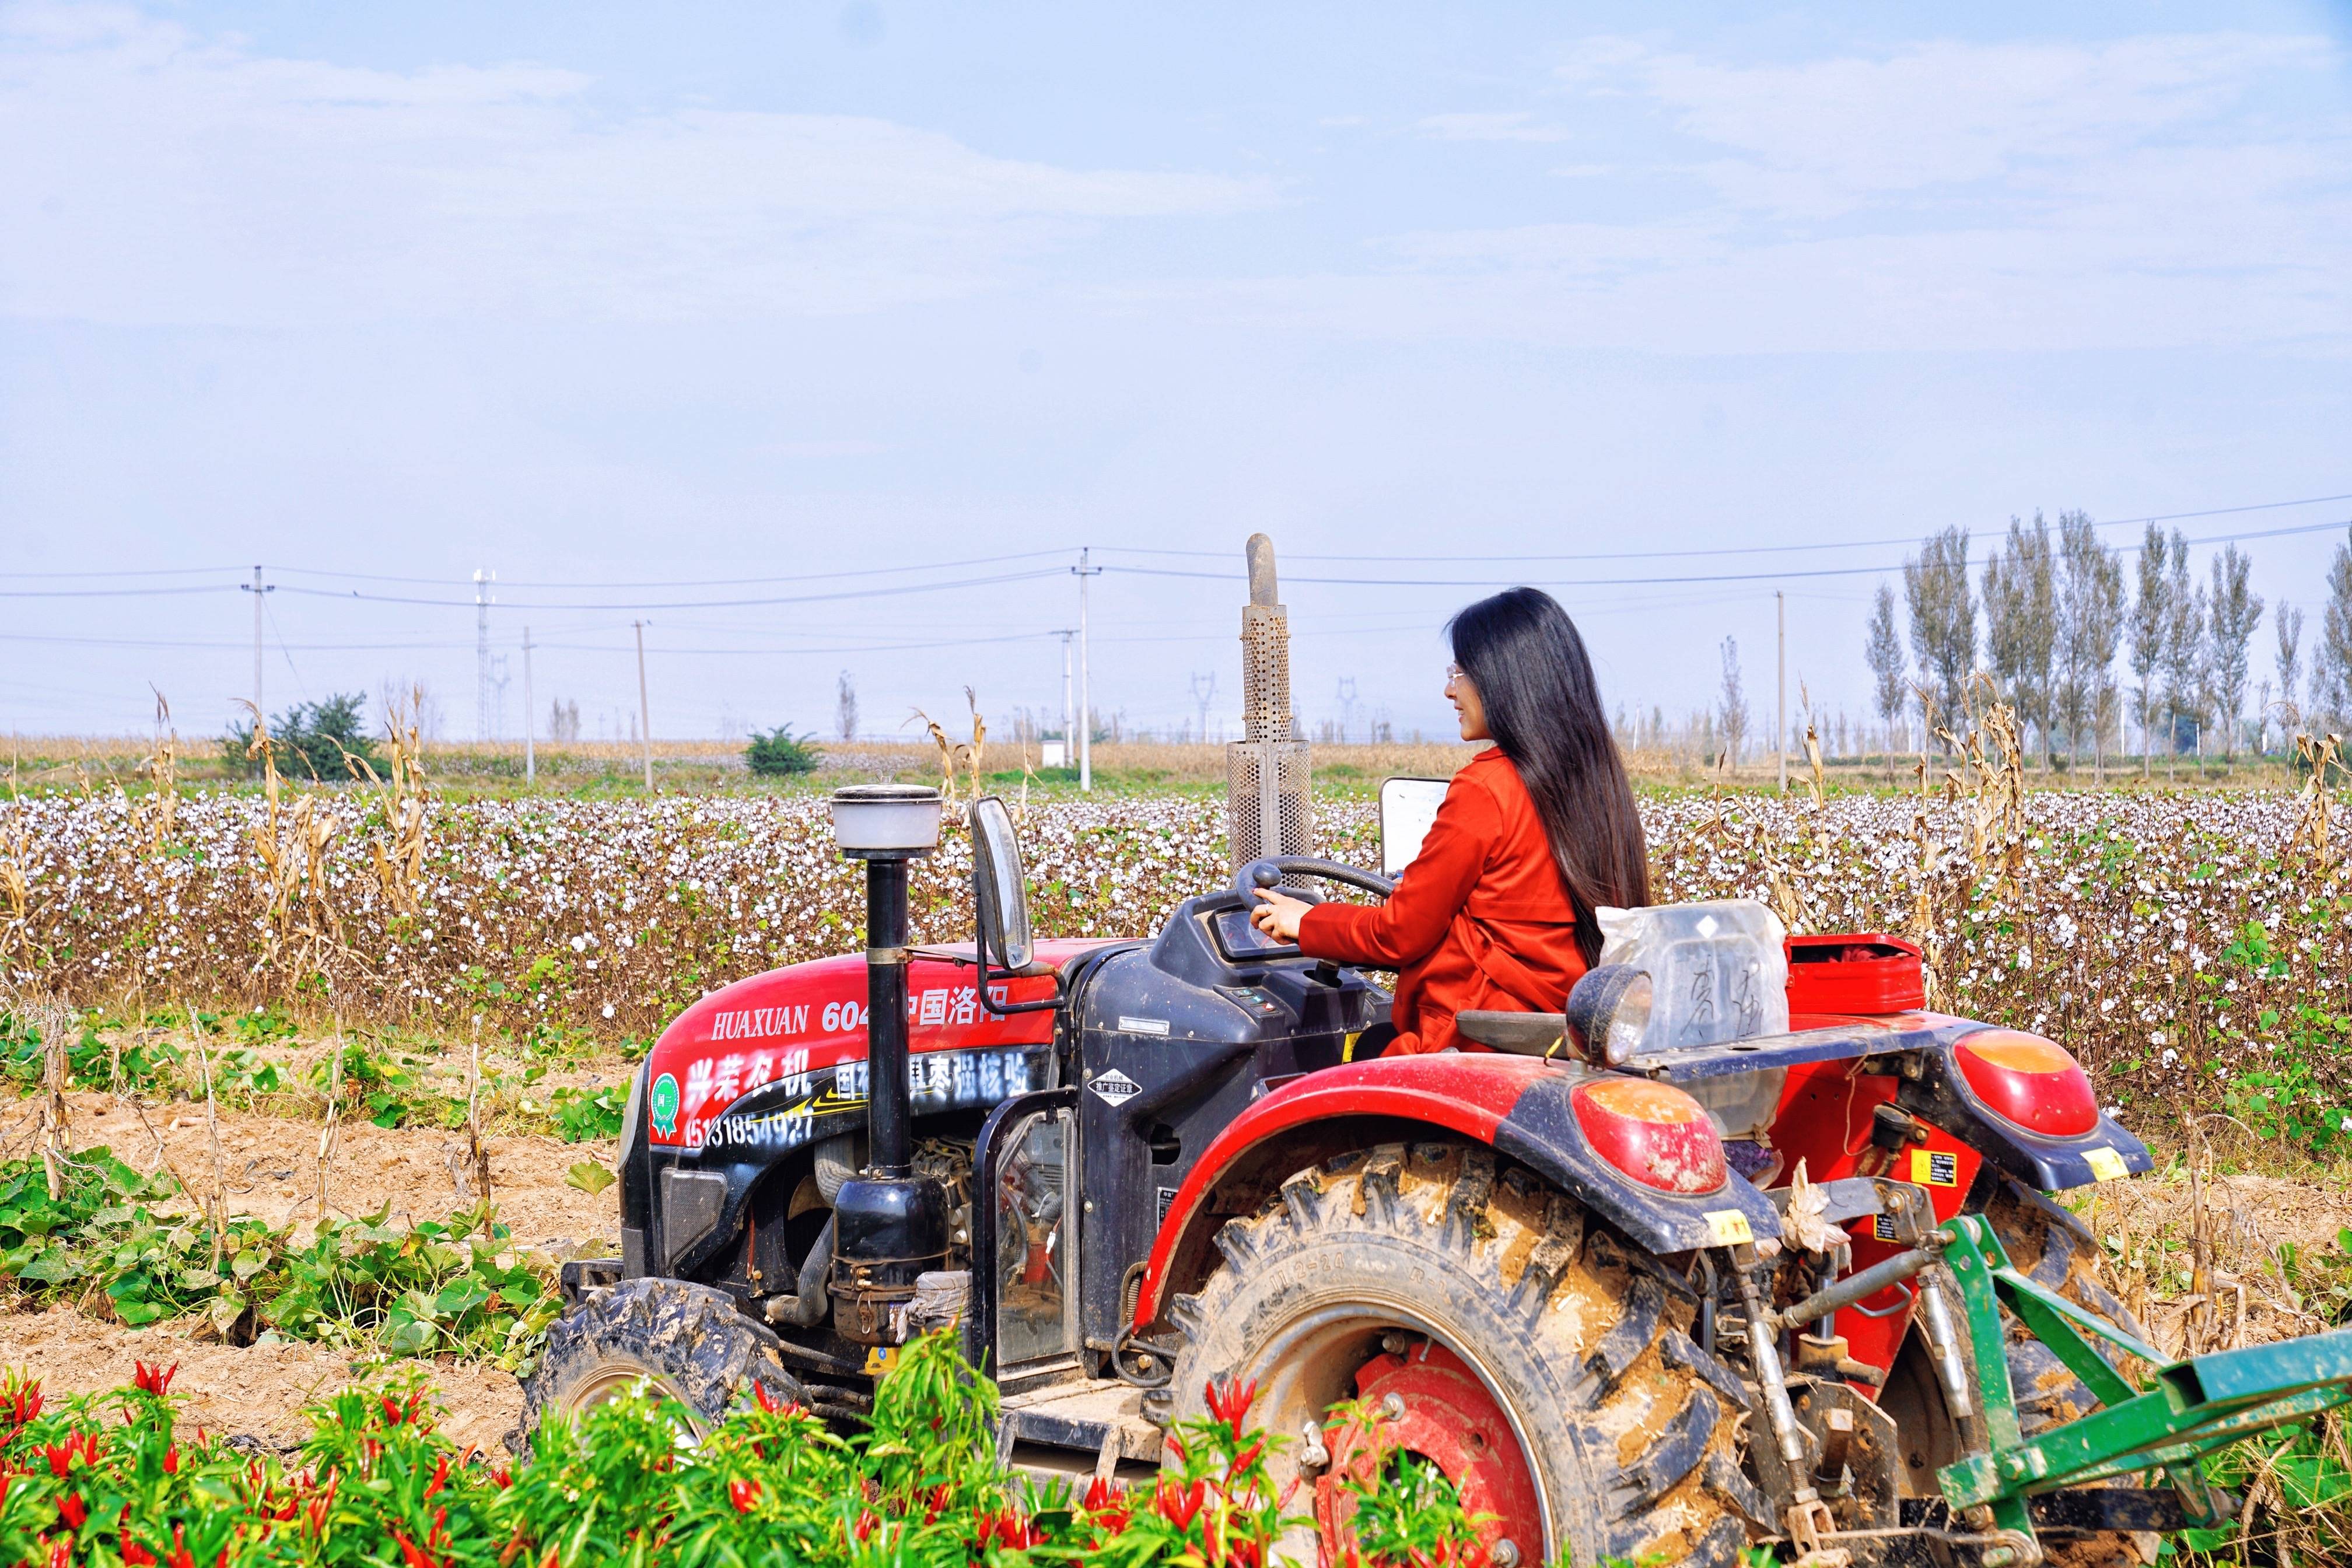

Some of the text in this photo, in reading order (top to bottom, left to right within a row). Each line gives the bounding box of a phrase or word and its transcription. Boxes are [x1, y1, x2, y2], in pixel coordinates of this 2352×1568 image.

[711, 1005, 810, 1041] HUAXUAN
[1096, 1081, 1133, 1094] 推广鉴定证章
[685, 1105, 815, 1148] 15131854927
[1269, 1252, 1346, 1291] 11.2-24
